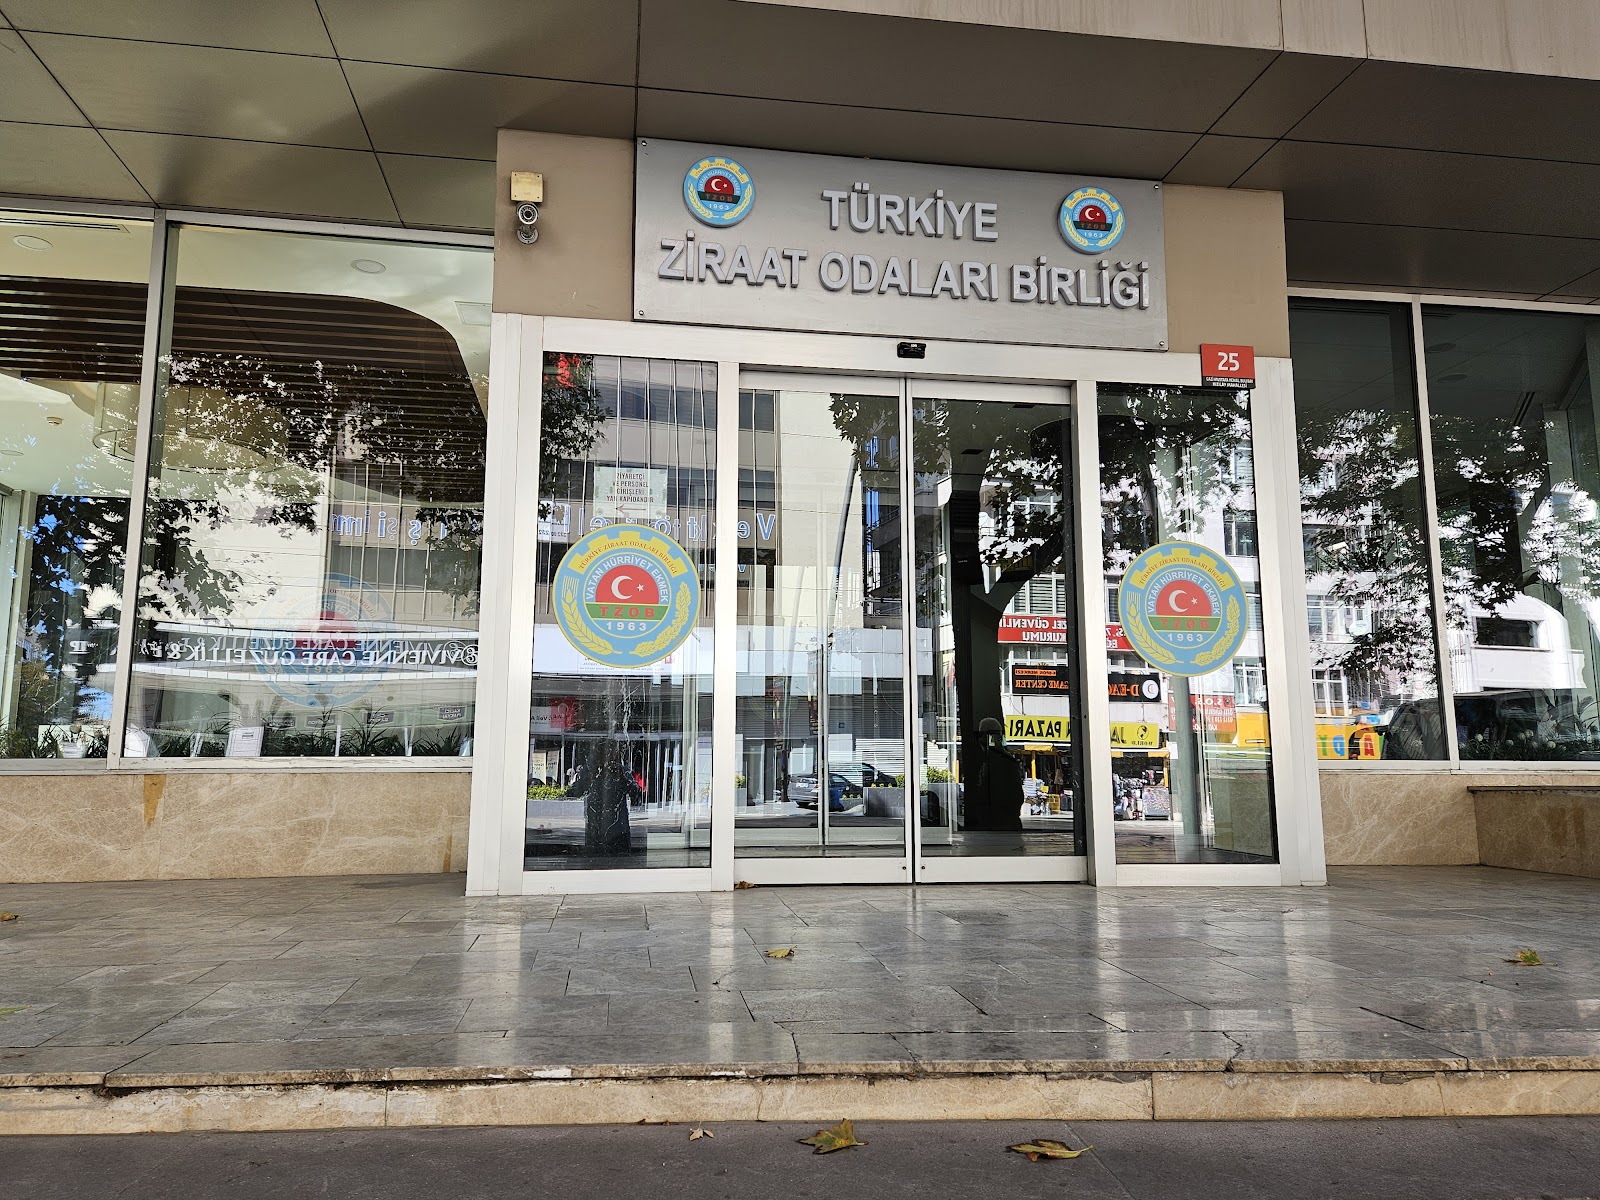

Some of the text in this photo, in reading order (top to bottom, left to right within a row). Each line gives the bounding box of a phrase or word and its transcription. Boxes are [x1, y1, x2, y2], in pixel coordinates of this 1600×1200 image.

[705, 194, 733, 202] TZOB
[822, 182, 998, 241] TÜRKİYE
[658, 229, 1149, 309] ZİRAAT ODALARI BİRLİĞİ
[1217, 351, 1240, 371] 25
[616, 472, 645, 481] ZİYARETÇİ
[619, 495, 654, 503] KAPIDANDR
[579, 540, 678, 575] TÜRKİYE ZİRAAT ODALARI BİRLİĞİ
[1159, 557, 1180, 568] ZİRAAT
[586, 554, 669, 602] VATAN HÜRRİYET EKMEK
[1148, 570, 1220, 614] VATAN HÜRRİYET EKMEK
[599, 606, 655, 618] TZOB
[606, 622, 647, 631] 1963
[1160, 619, 1209, 630] TZOB
[1168, 633, 1203, 642] 1963
